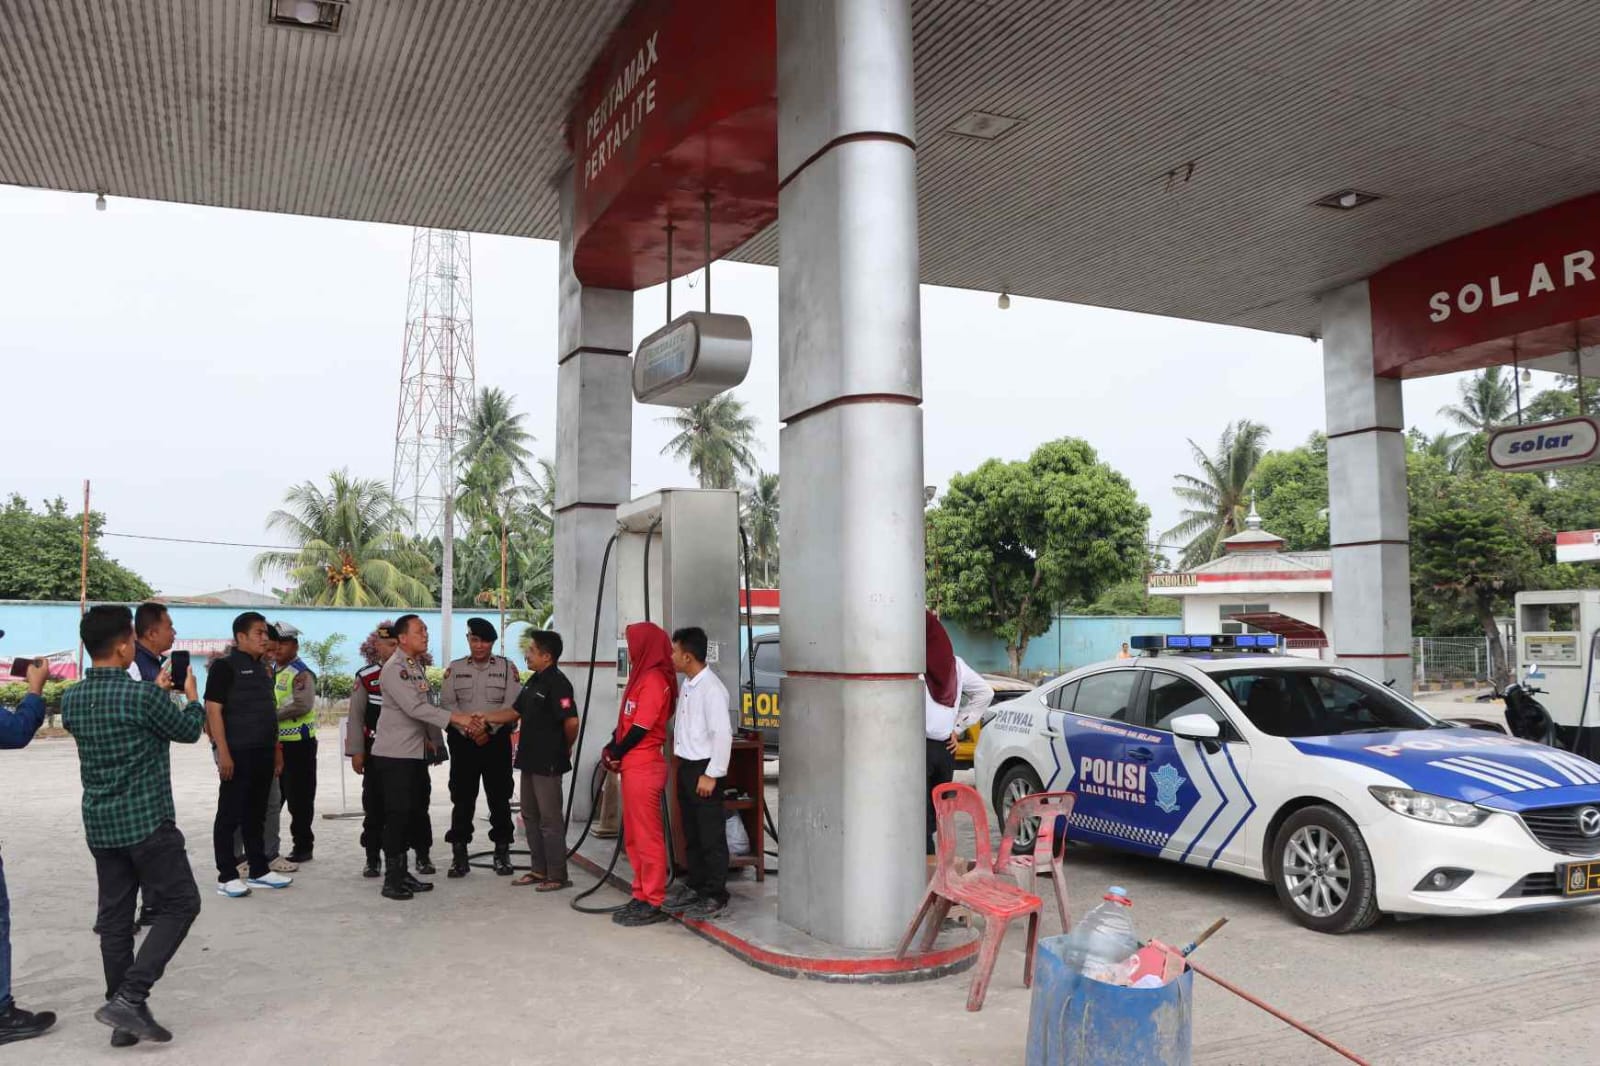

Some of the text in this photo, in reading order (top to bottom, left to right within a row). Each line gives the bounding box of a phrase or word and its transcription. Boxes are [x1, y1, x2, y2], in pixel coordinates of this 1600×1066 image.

[586, 30, 658, 147] PERTAMAX
[584, 79, 657, 189] PERTALITE
[1428, 249, 1597, 323] SOLAR
[1508, 432, 1574, 455] solar
[743, 692, 780, 716] POL
[995, 710, 1033, 727] PATWAL
[1080, 756, 1147, 793] POLISI
[1080, 783, 1146, 804] LALU LINTAS
